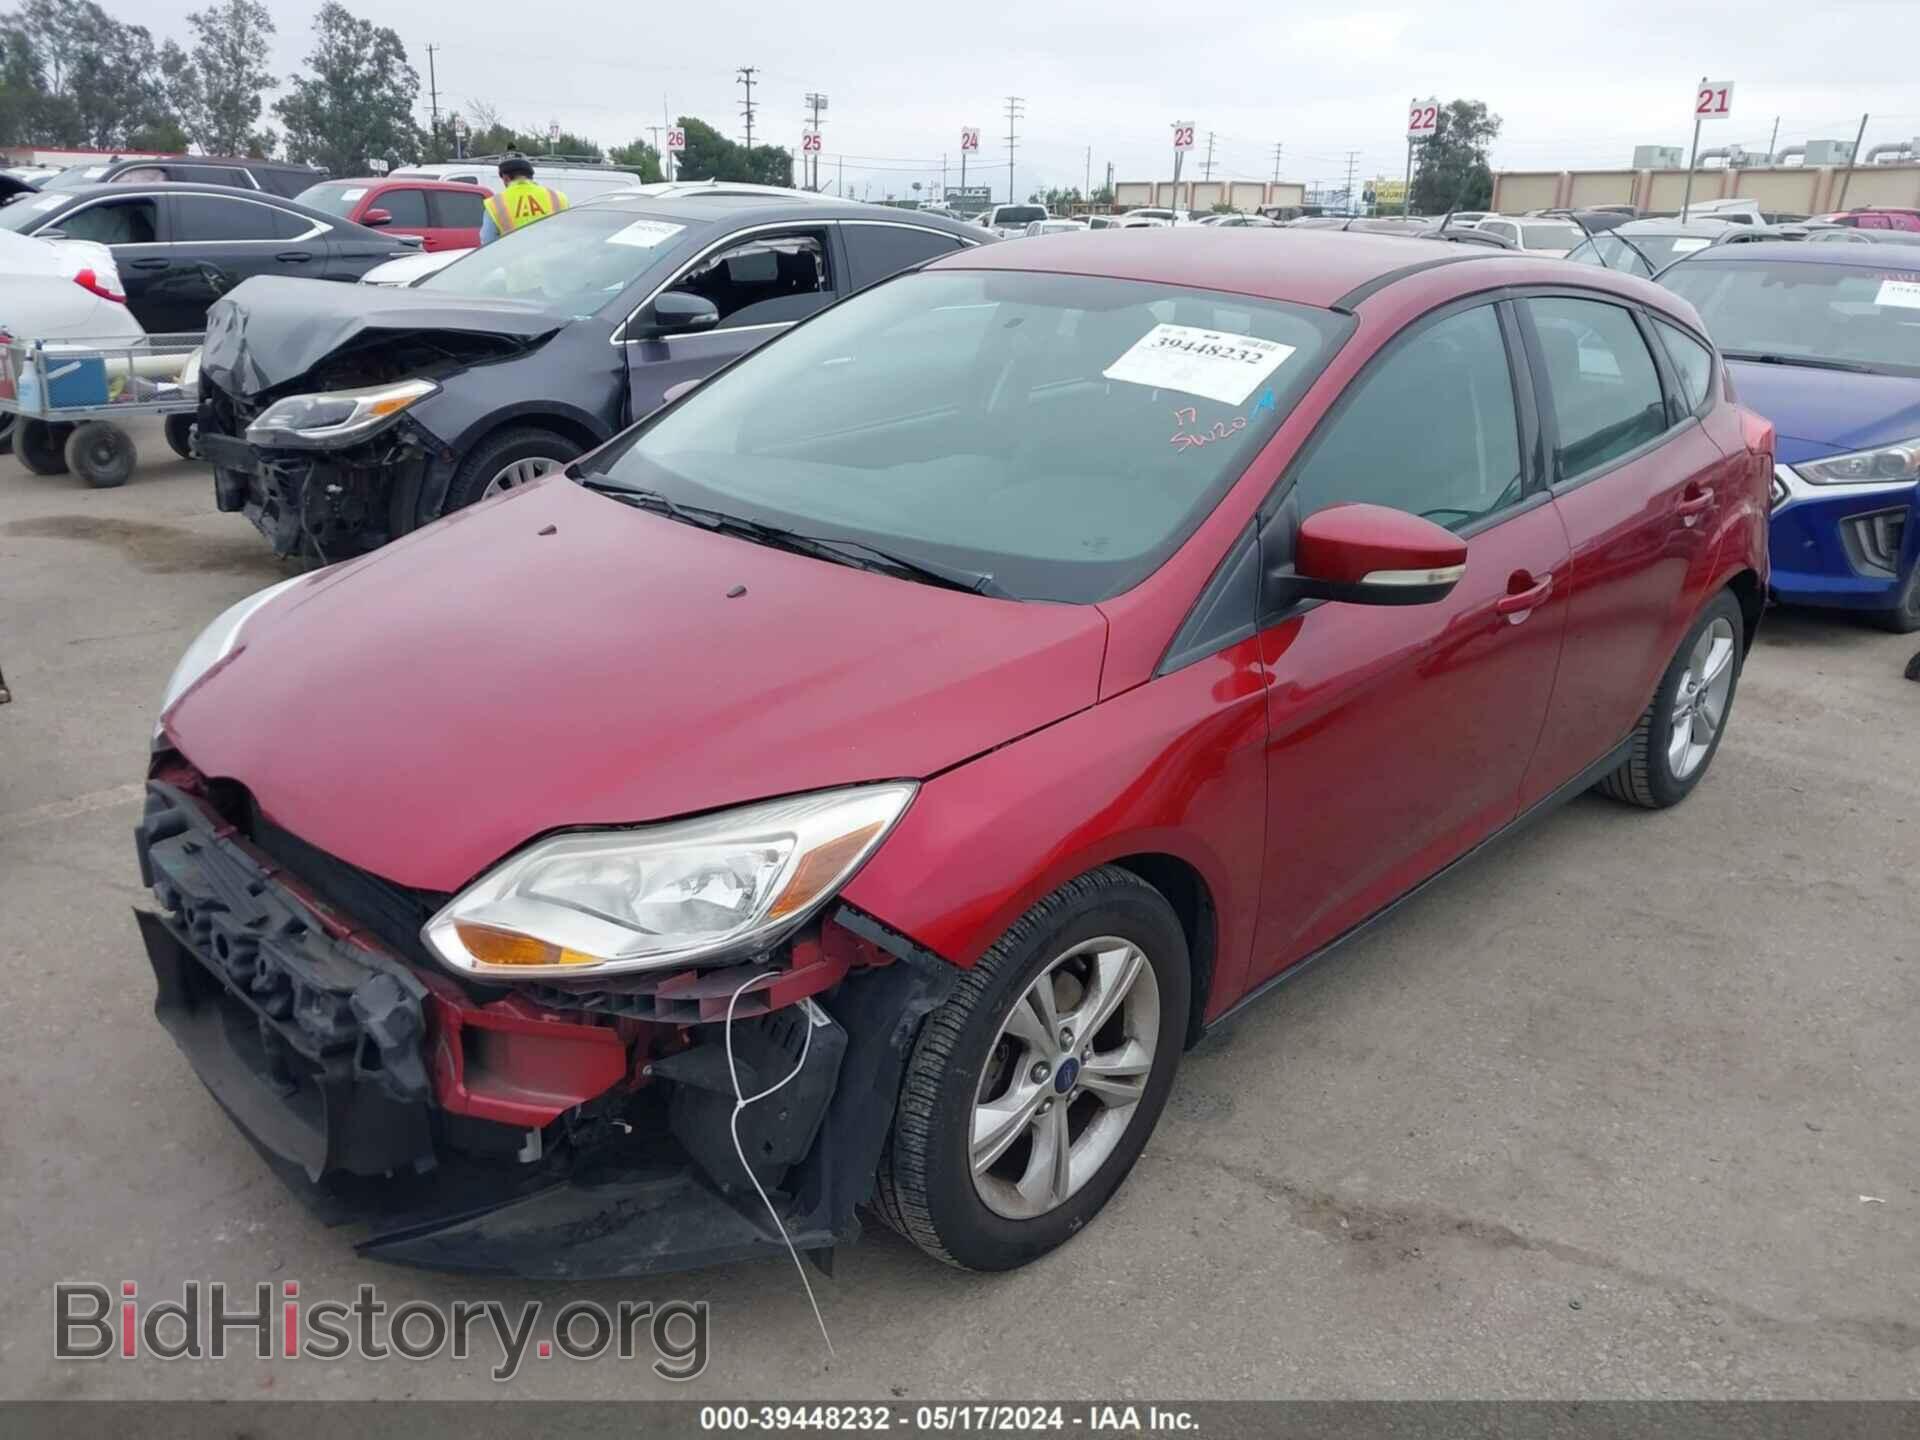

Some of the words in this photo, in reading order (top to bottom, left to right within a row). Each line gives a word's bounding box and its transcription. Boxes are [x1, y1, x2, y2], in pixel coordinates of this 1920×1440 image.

[1696, 88, 1729, 113] 21
[1409, 106, 1436, 130] 22
[668, 131, 684, 146] 26
[803, 135, 822, 151] 25
[961, 132, 978, 150] 24
[1175, 127, 1193, 146] 23
[1151, 337, 1264, 365] 39448232
